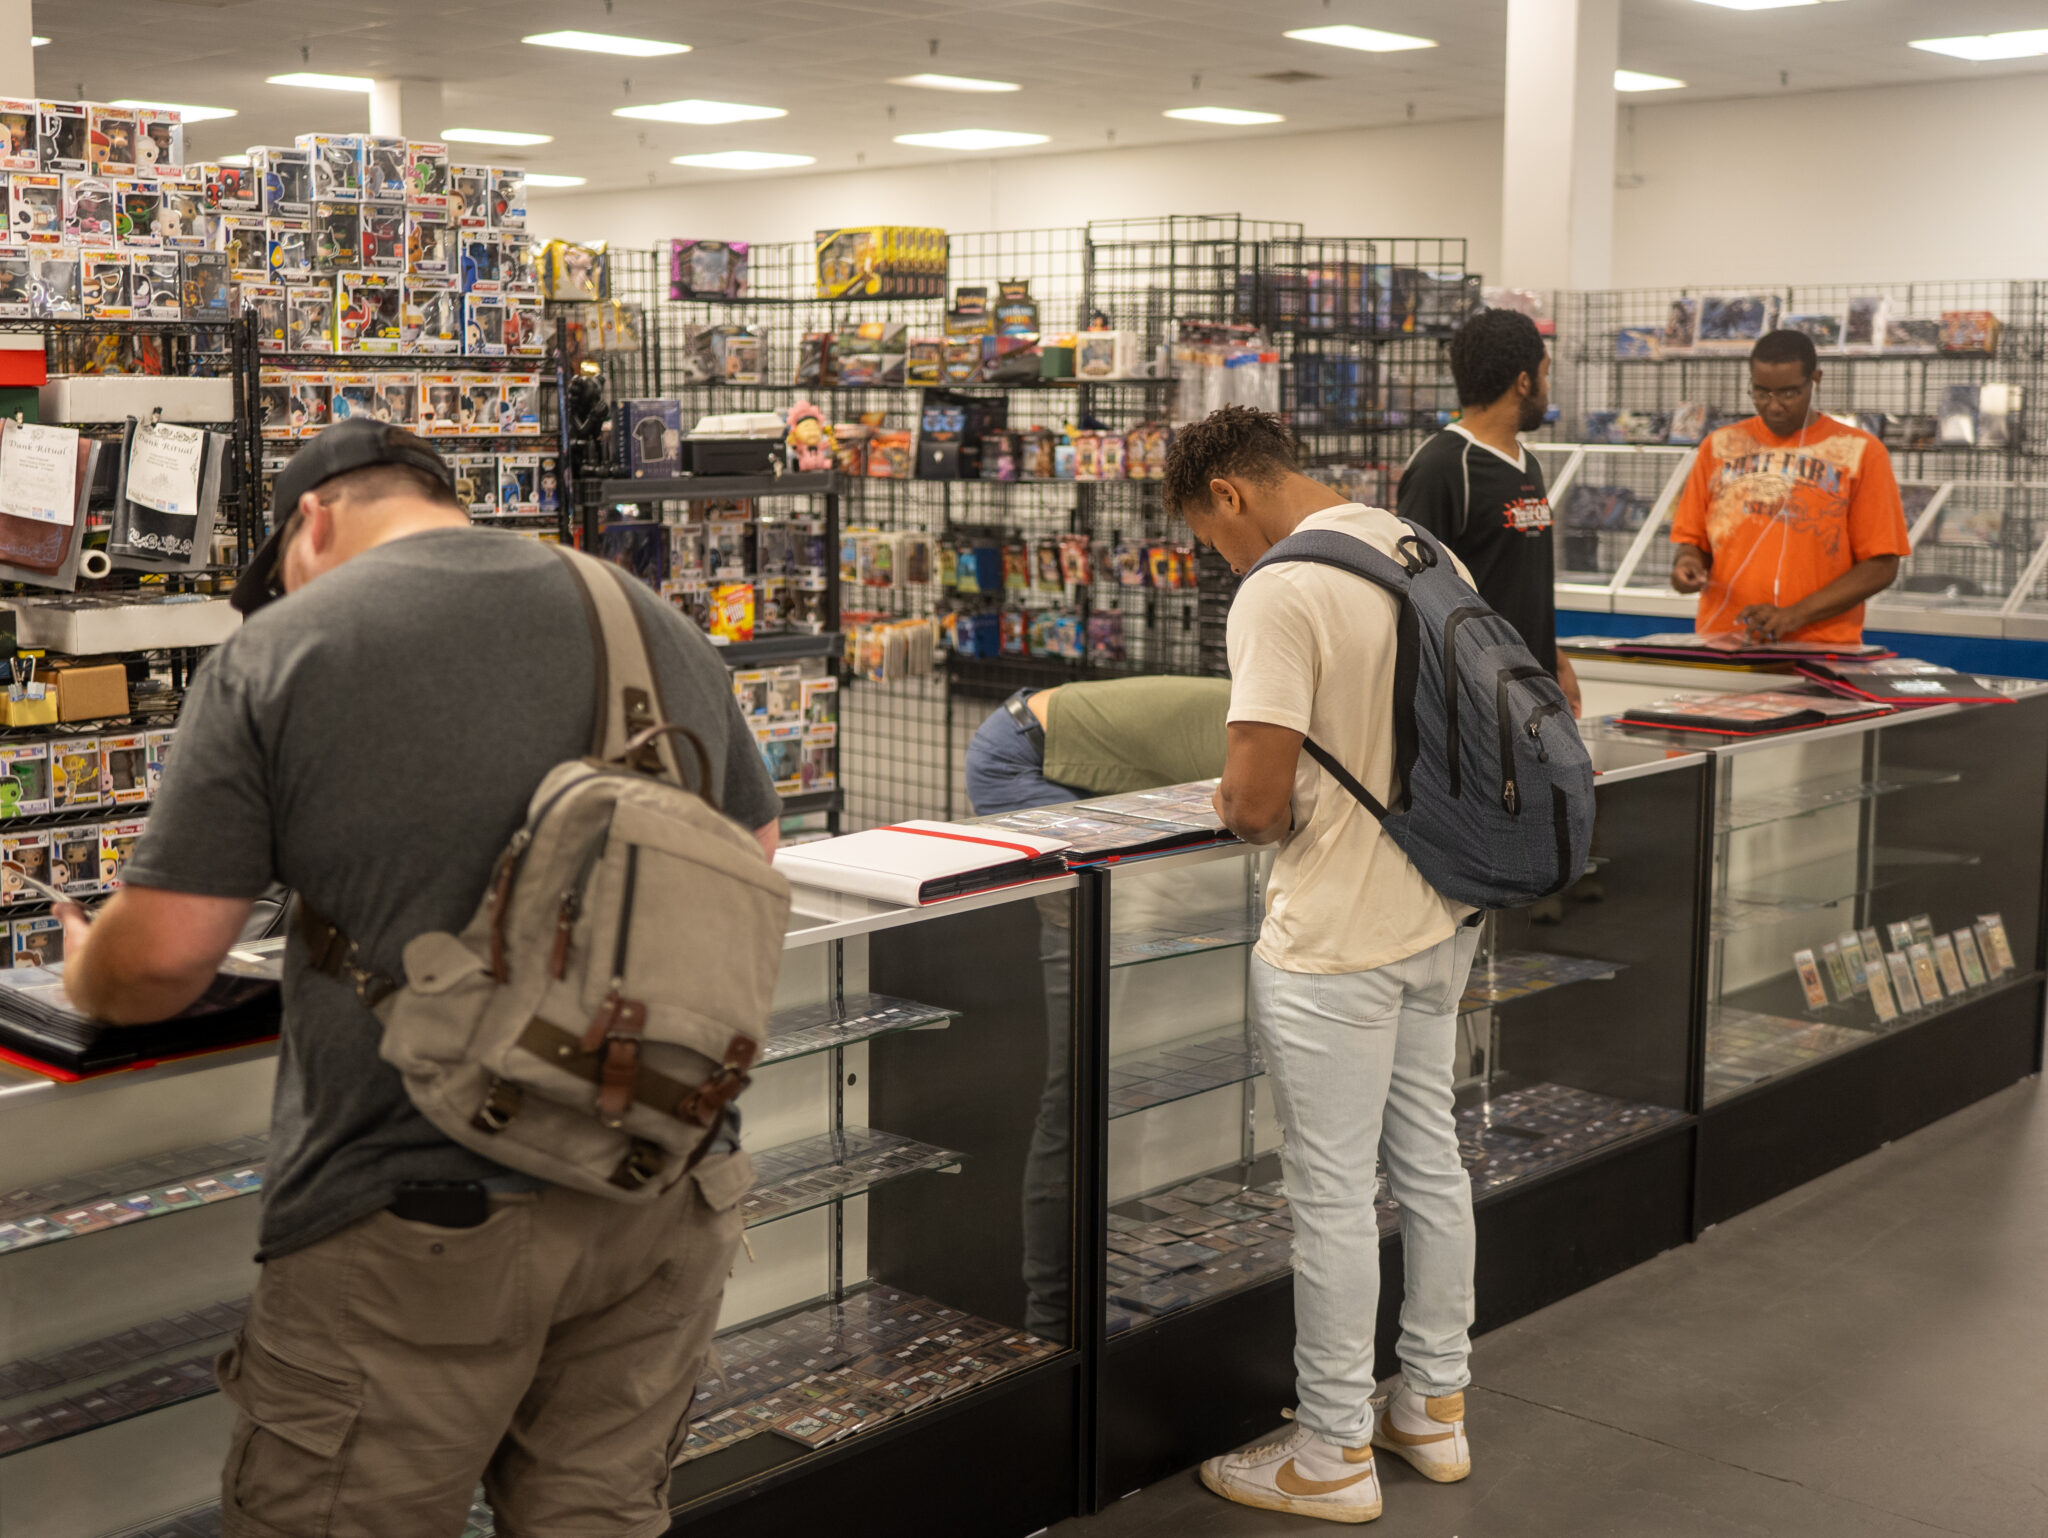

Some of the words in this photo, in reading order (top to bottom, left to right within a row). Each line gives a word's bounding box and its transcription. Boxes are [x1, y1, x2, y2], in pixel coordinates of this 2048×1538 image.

[8, 439, 33, 451] Dank
[36, 443, 68, 455] Ritual
[161, 441, 194, 455] Ritual
